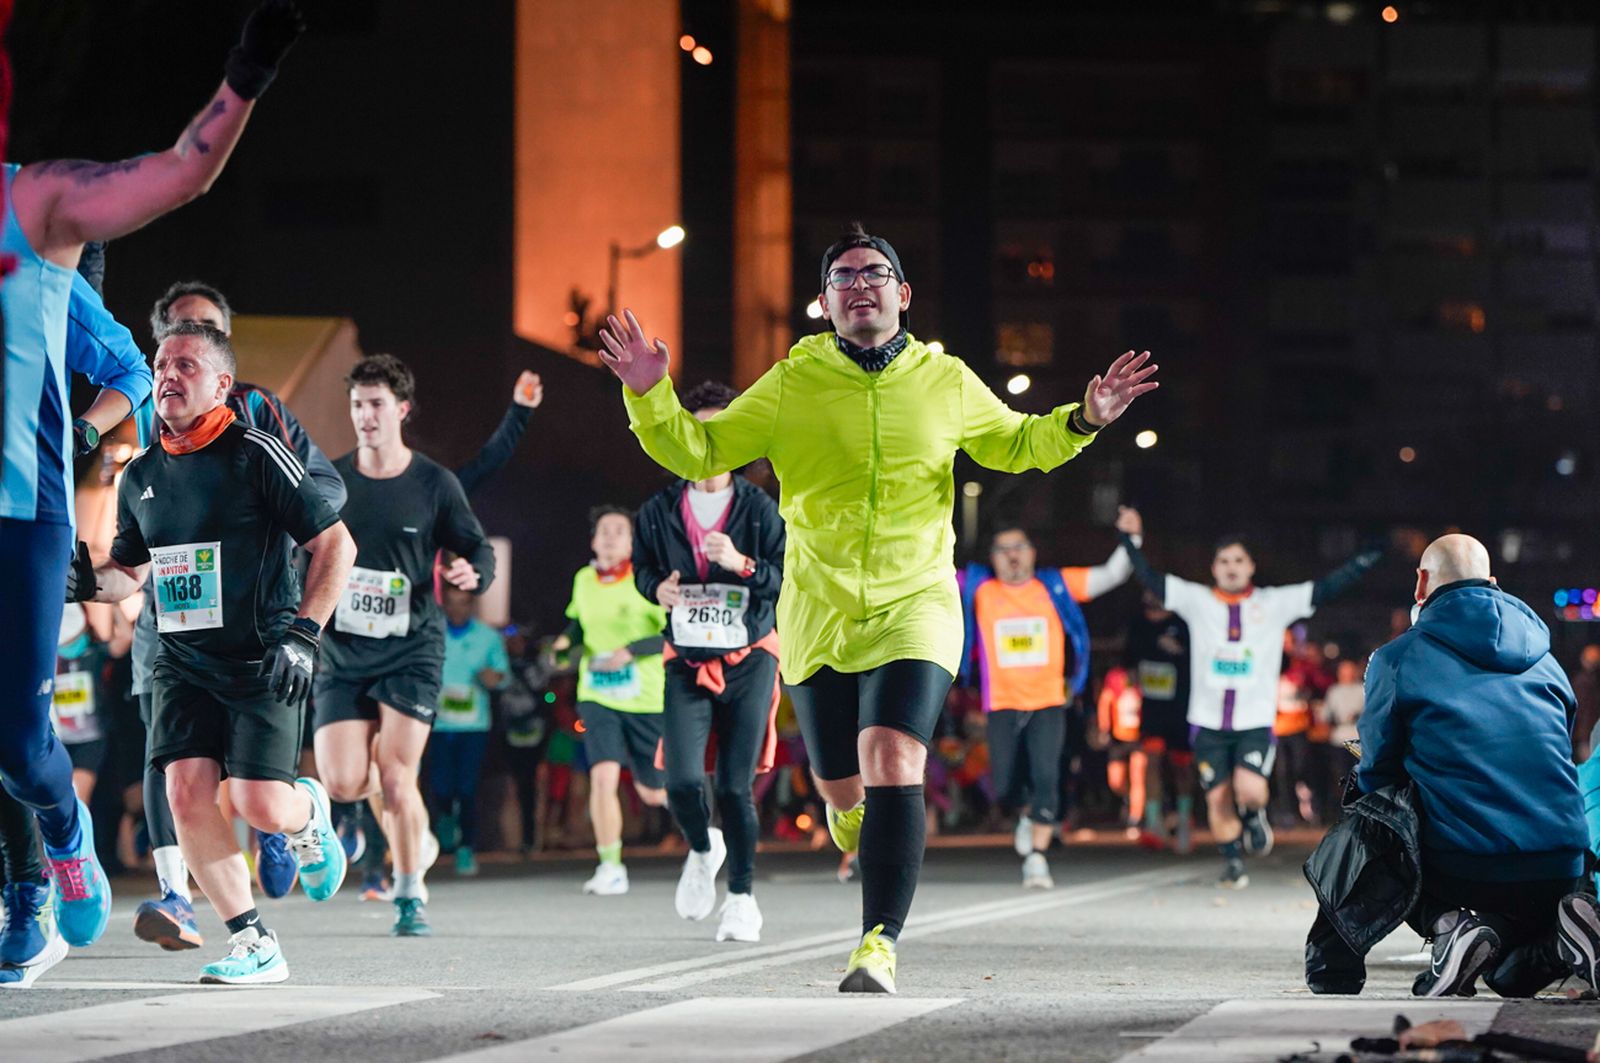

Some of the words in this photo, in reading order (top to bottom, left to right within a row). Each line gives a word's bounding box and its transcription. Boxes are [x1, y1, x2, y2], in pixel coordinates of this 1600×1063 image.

[163, 574, 202, 602] 1138
[351, 592, 395, 616] 6930
[687, 606, 732, 627] 2630
